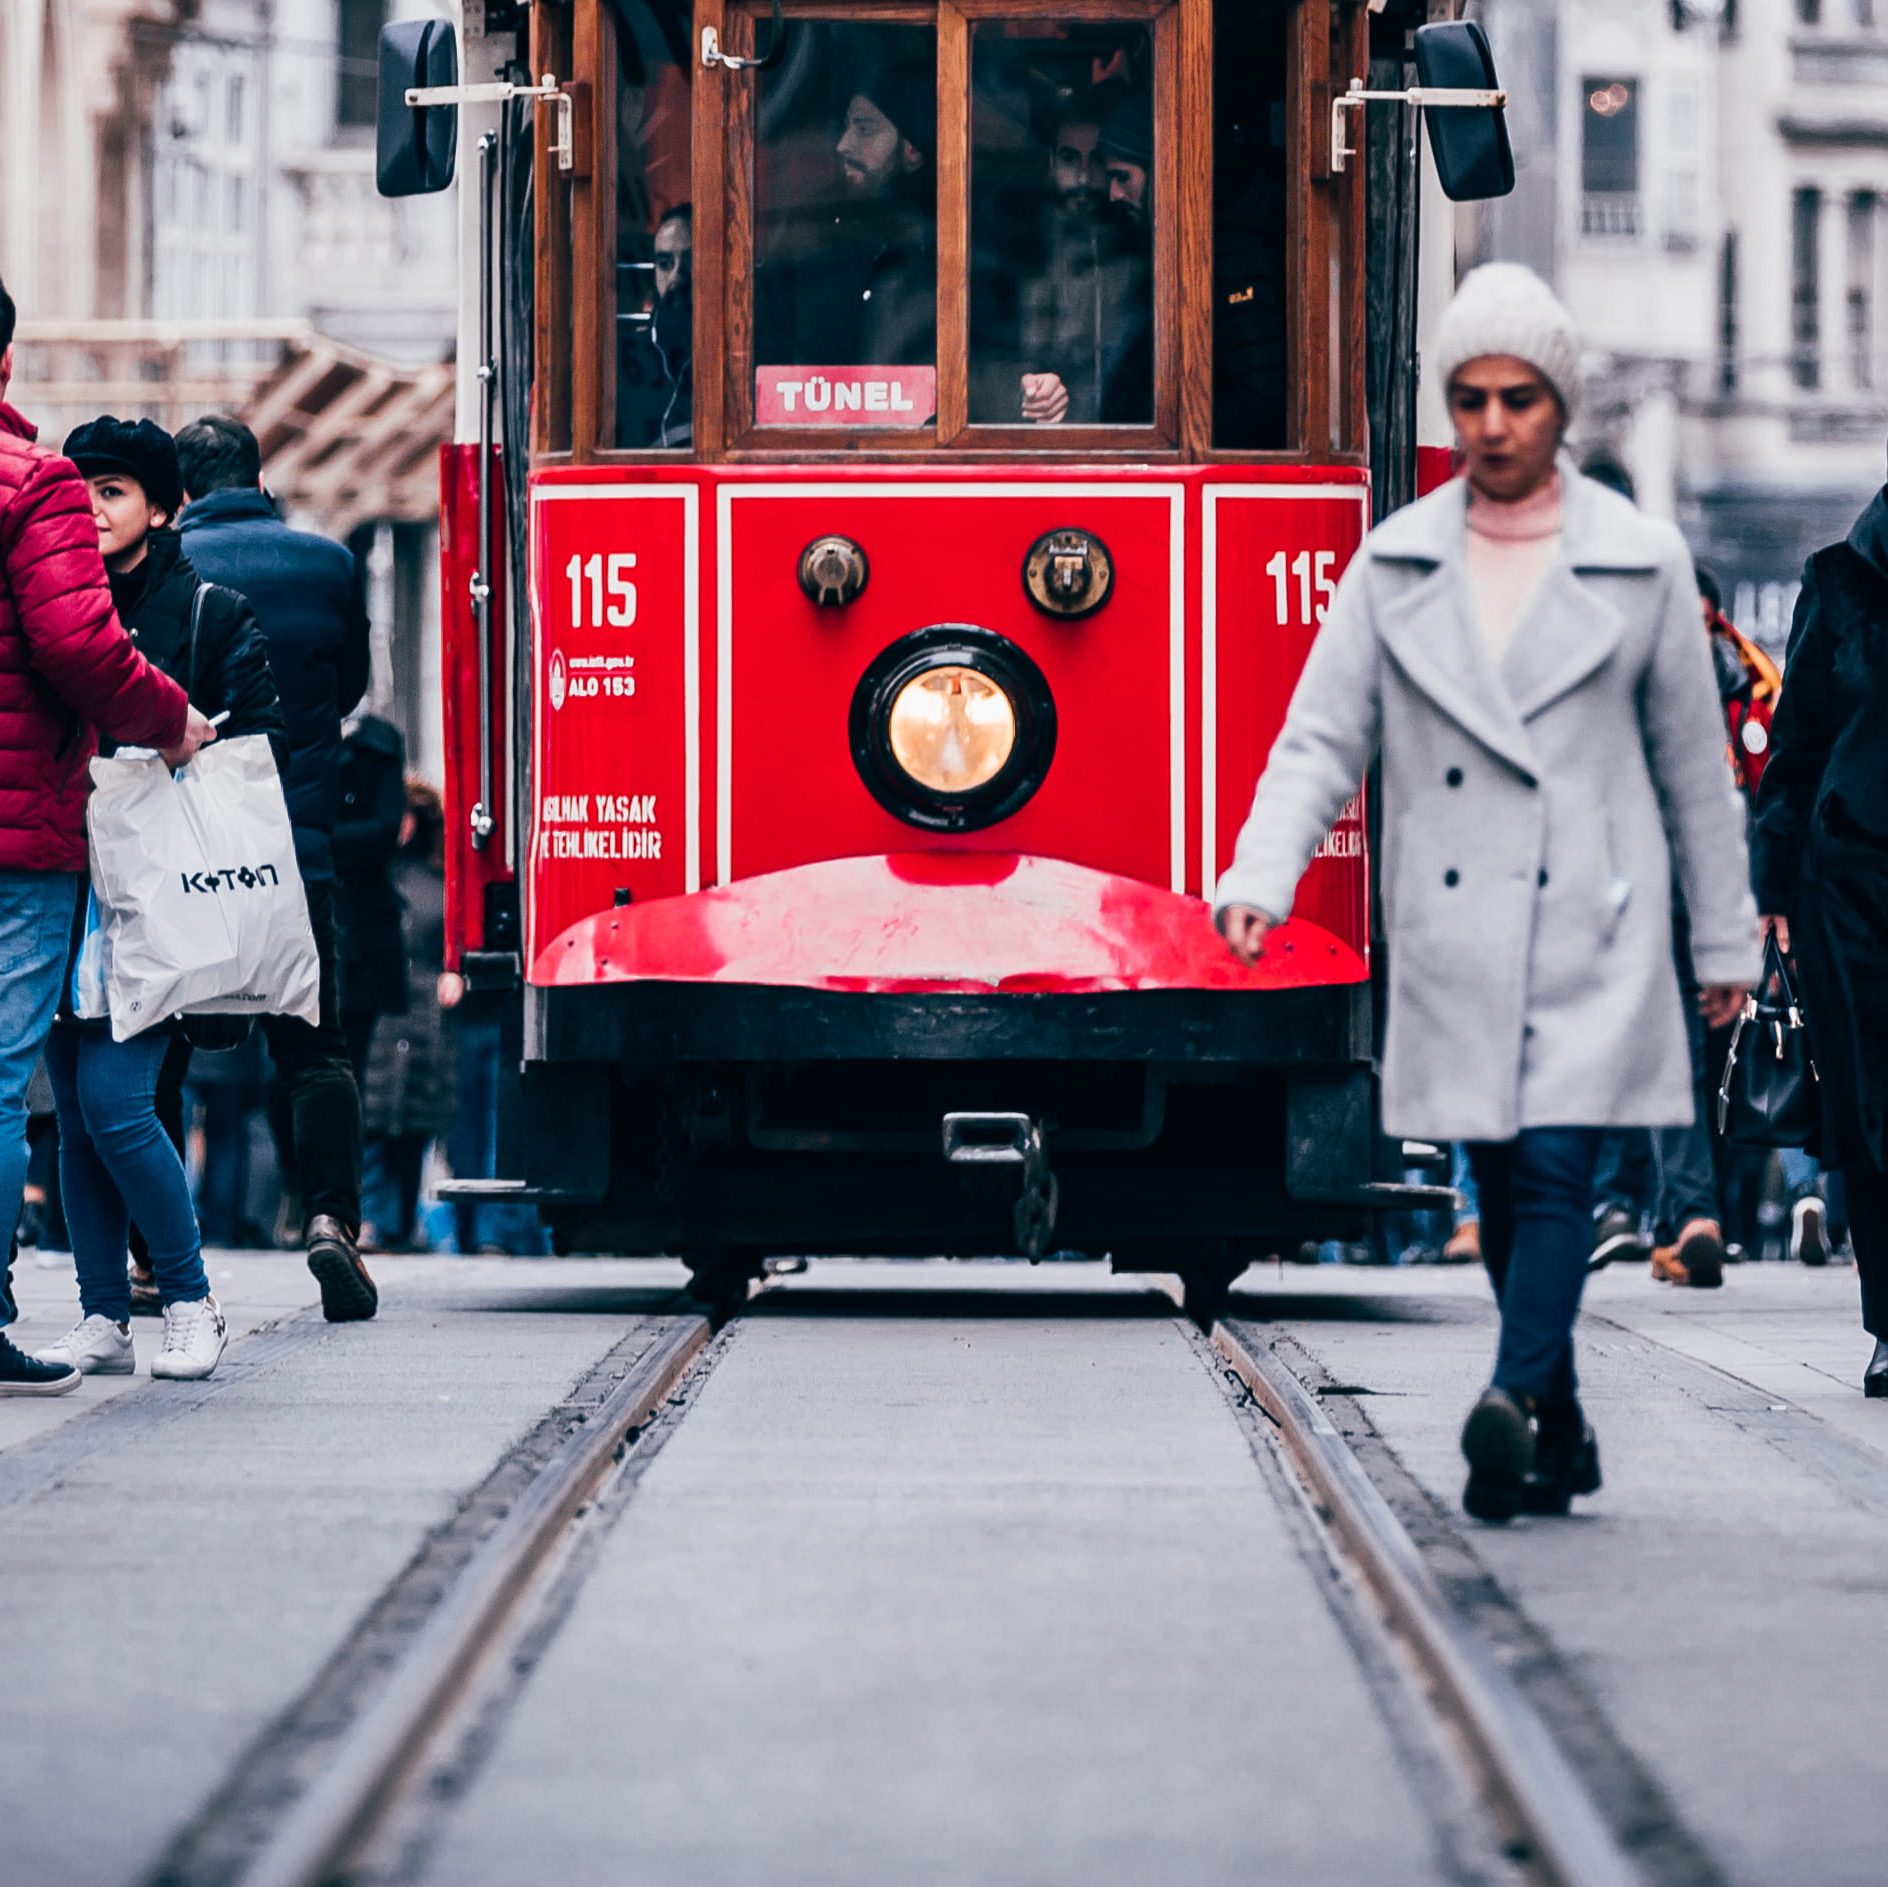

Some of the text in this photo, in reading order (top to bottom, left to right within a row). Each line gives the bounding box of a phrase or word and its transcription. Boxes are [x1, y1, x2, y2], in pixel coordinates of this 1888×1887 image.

[776, 376, 914, 412] TÜNEL
[566, 553, 637, 628] 115
[1266, 551, 1336, 625] 115
[603, 677, 635, 697] 153
[595, 795, 656, 823] YASAK
[553, 826, 661, 859] TEHLİKELİDİR
